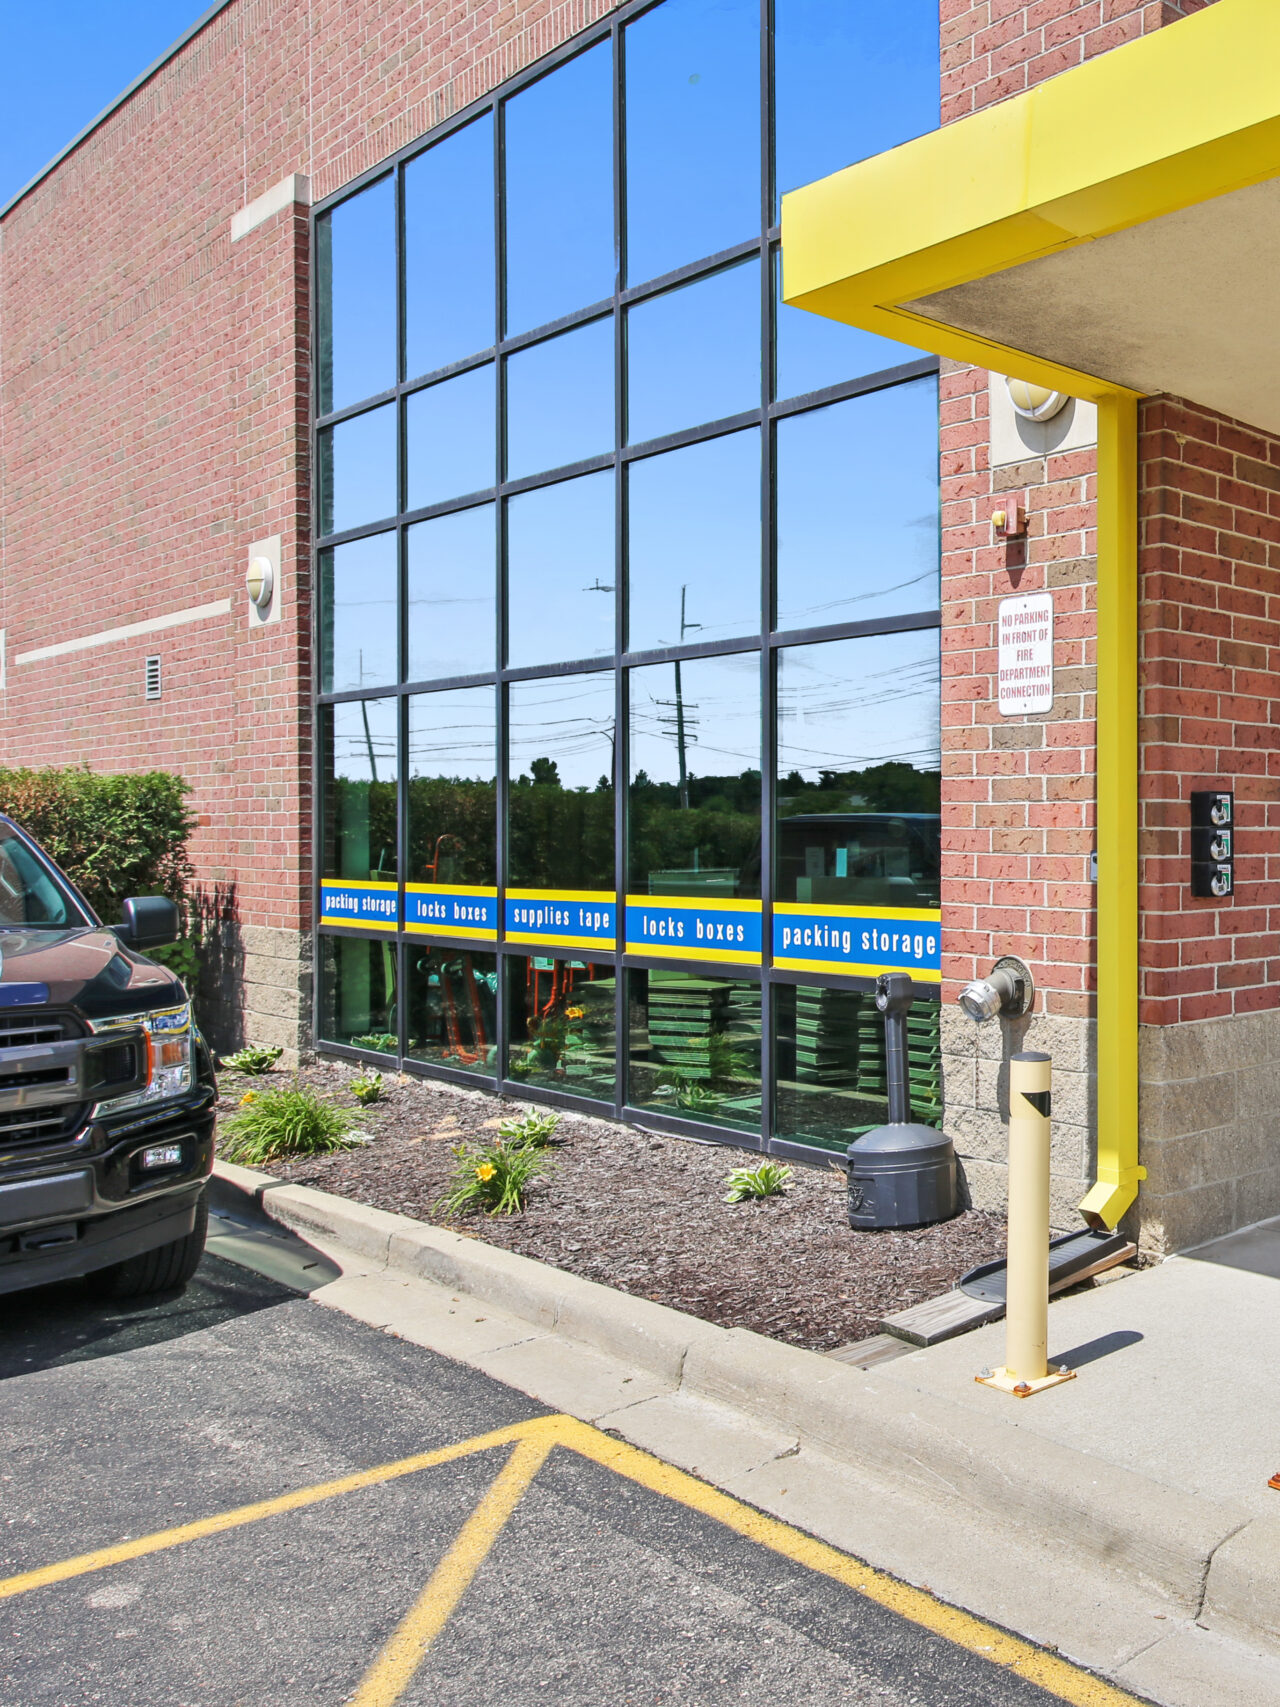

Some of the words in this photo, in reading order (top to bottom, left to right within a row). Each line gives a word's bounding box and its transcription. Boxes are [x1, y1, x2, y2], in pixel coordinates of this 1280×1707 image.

[1002, 614, 1012, 627] NO
[1014, 609, 1049, 626] PARKING
[1002, 632, 1010, 645] IN
[1012, 629, 1037, 644] FRONT
[1039, 628, 1048, 641] OF
[1017, 648, 1033, 662] FIRE
[1000, 664, 1051, 681] DEPARTMENT
[1000, 683, 1050, 700] CONNECTION
[326, 893, 358, 913] packing
[362, 895, 396, 916] storage
[417, 900, 446, 919] locks
[453, 902, 487, 922] boxes
[514, 906, 570, 928] supplies
[579, 908, 610, 931] tape
[643, 915, 684, 938] locks
[696, 918, 744, 942] boxes
[783, 923, 851, 954] packing
[861, 928, 936, 959] storage
